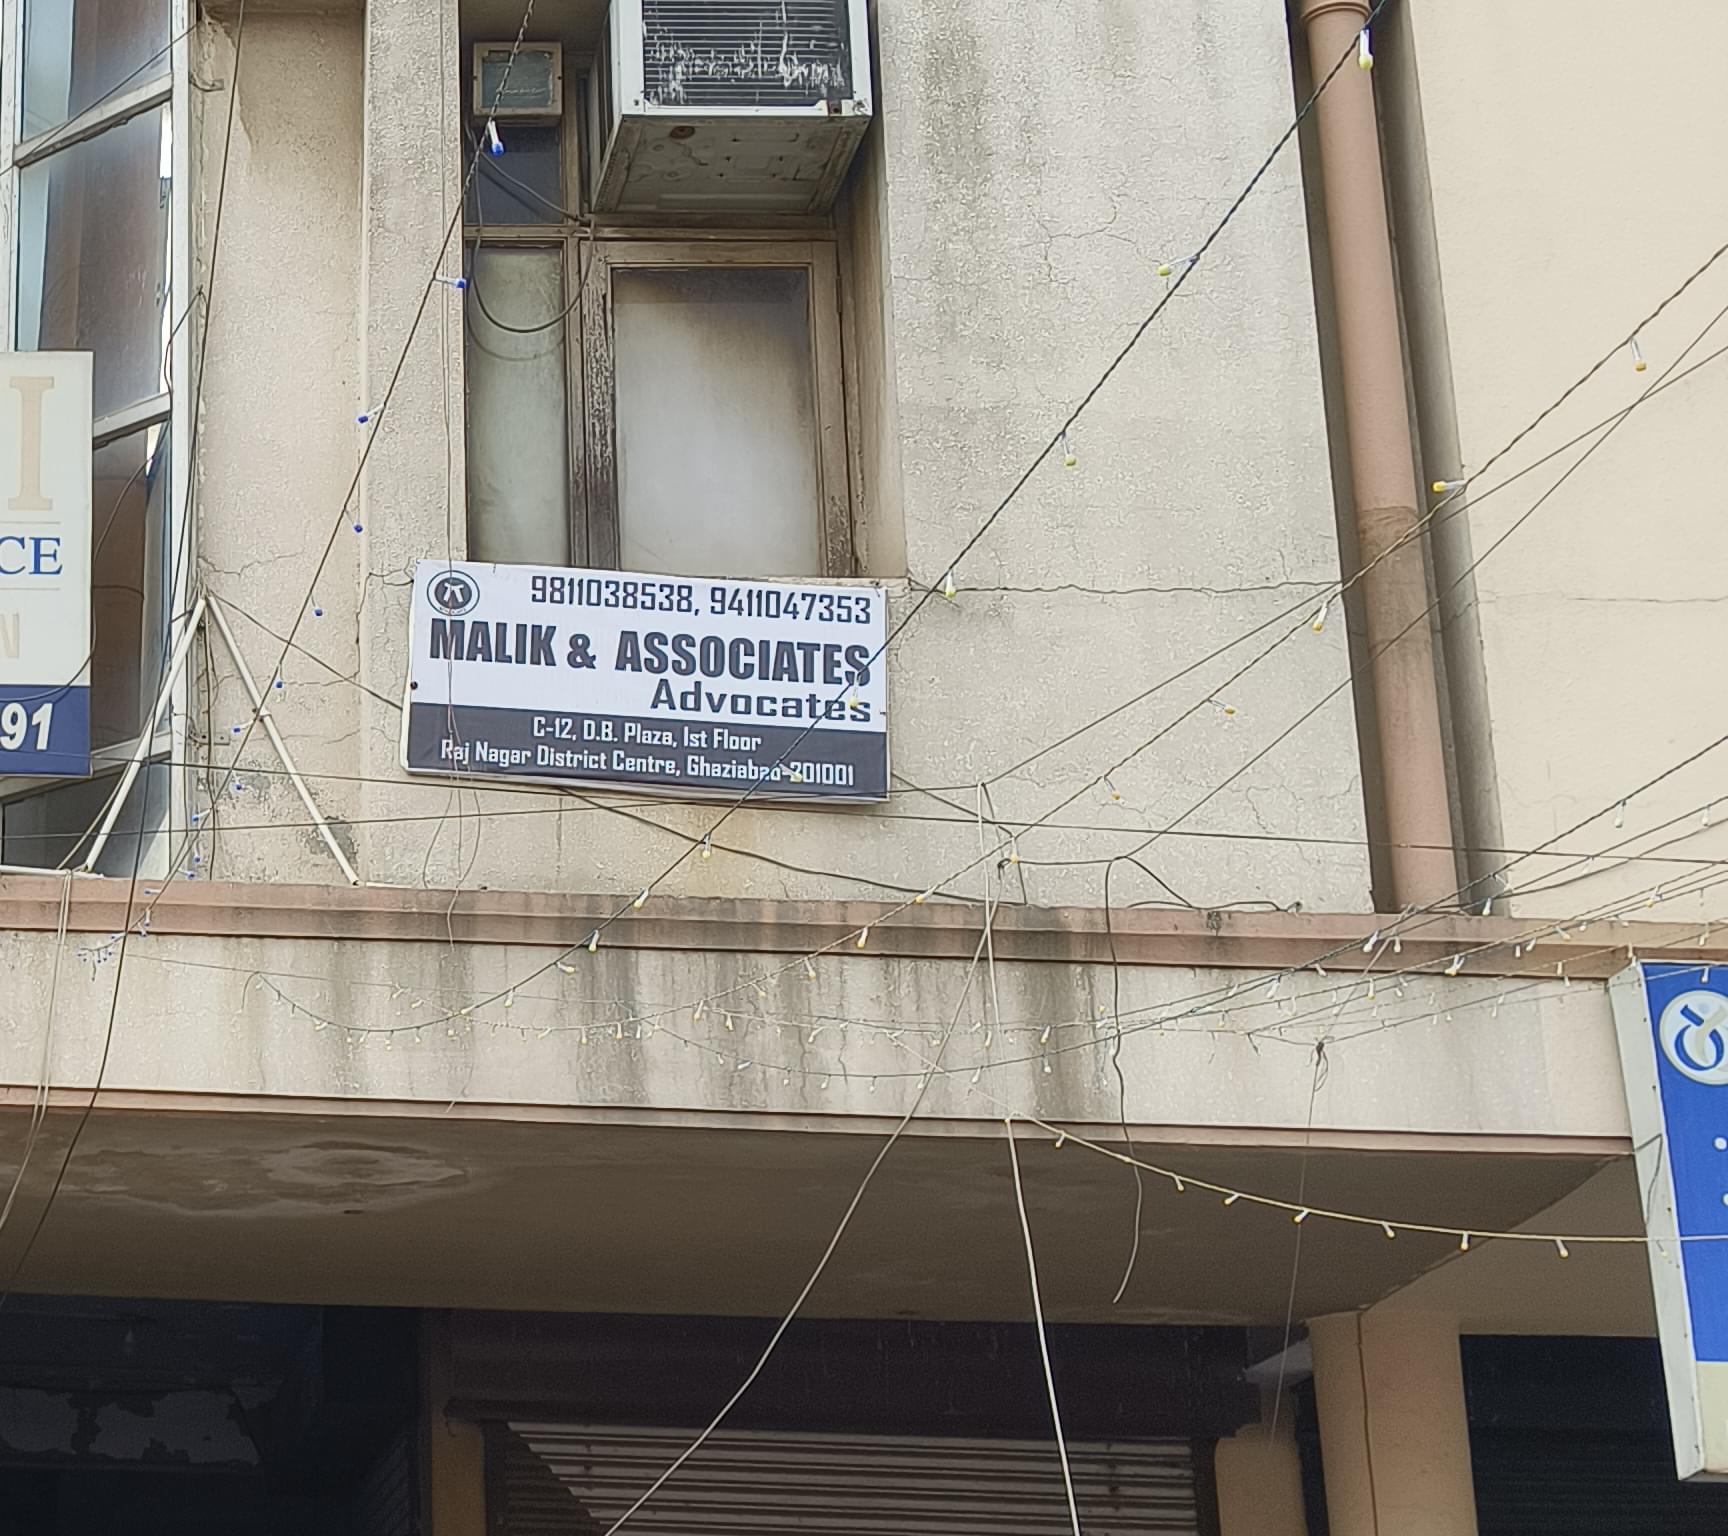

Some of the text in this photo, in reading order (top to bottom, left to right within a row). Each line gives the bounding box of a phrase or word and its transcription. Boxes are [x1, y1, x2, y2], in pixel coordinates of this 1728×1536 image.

[532, 576, 871, 624] 9811038538, 9411047353
[430, 618, 870, 687] MALIK & ASSOCIATES
[650, 678, 870, 722] Advocates
[533, 716, 576, 741] C-12,
[583, 719, 618, 742] D.B.
[624, 723, 677, 748] Plaza,
[713, 728, 762, 751] Floor
[441, 739, 470, 764] Raj
[476, 741, 531, 766] Nagar
[537, 745, 606, 770] District
[613, 750, 680, 776] Centre,
